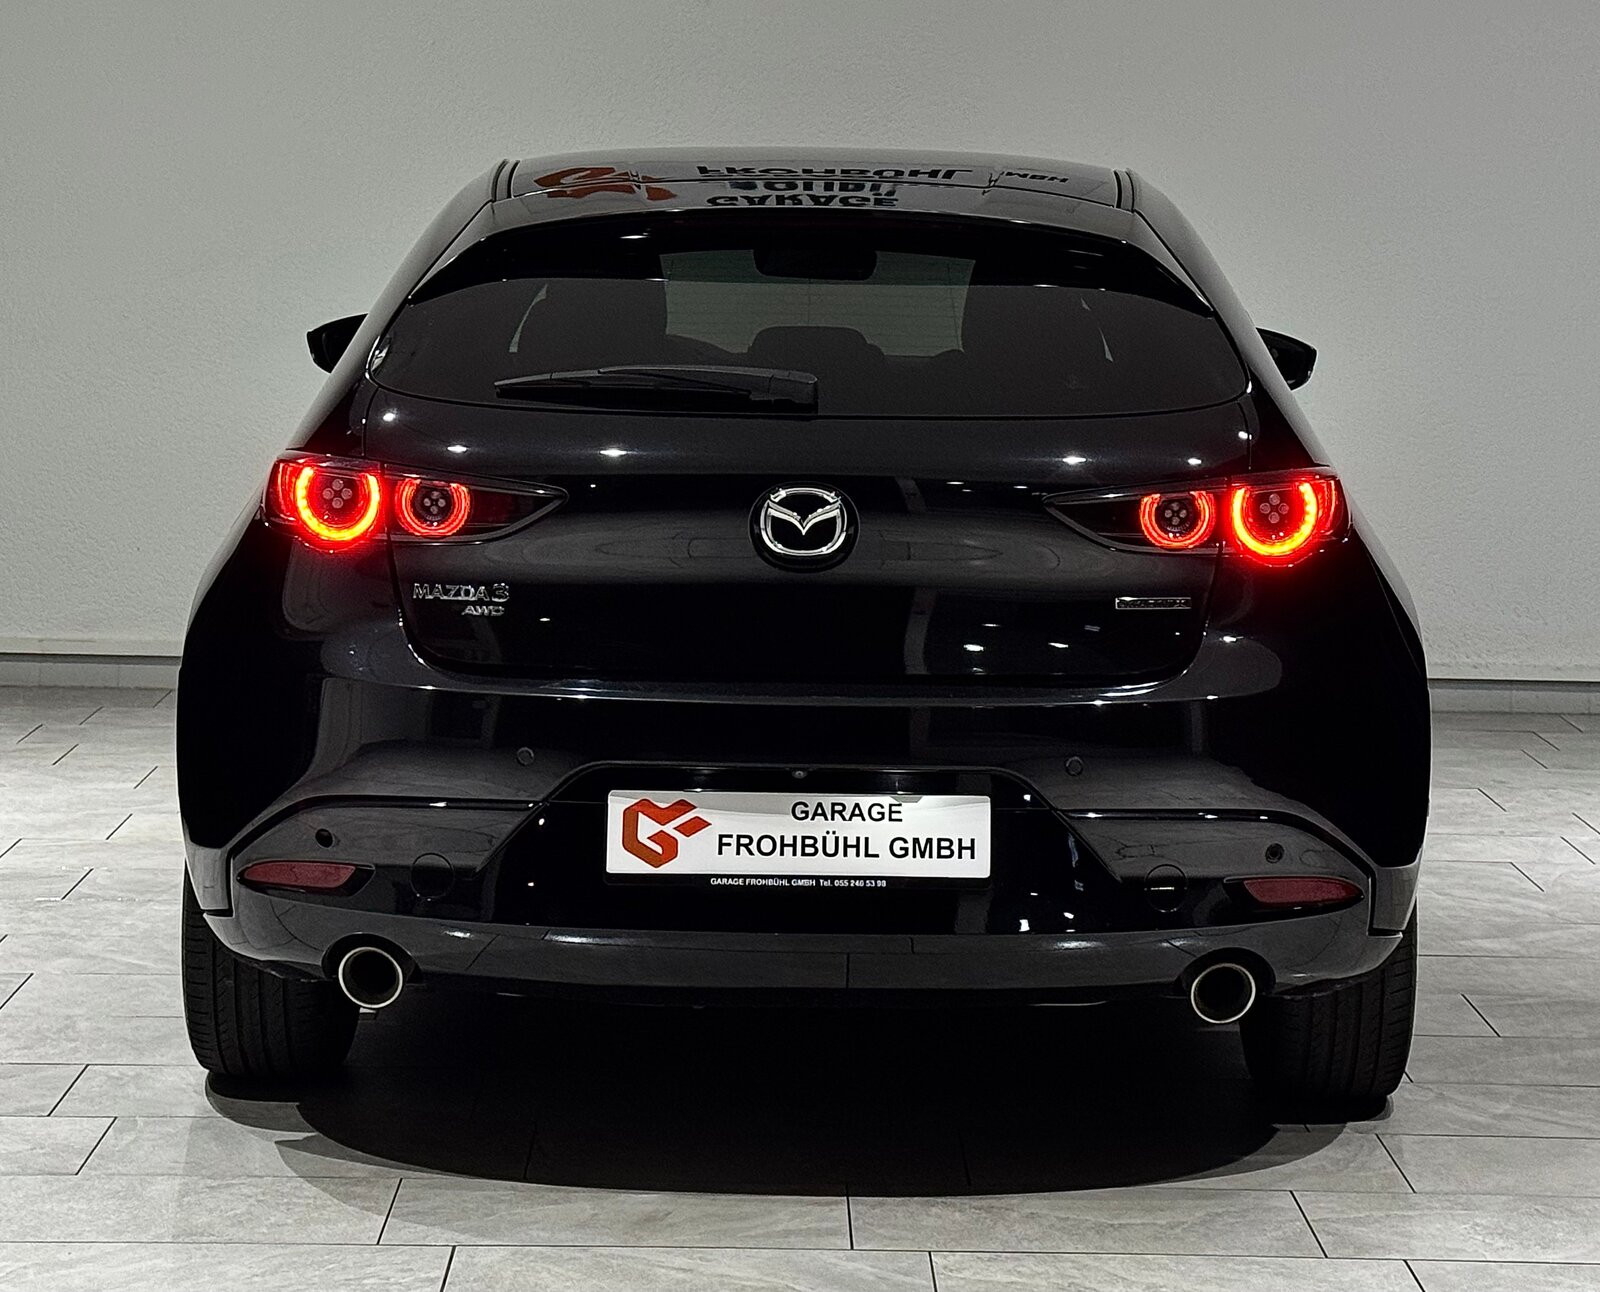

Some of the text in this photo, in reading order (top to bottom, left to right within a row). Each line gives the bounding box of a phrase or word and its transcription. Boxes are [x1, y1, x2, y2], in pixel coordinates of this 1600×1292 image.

[461, 605, 505, 616] AWD
[791, 801, 904, 822] GARAGE
[717, 830, 976, 860] FROHBÜHL GMBH
[710, 877, 744, 886] GARAGE
[746, 877, 790, 887] FROHBÜHL
[791, 879, 816, 887] GMBH
[820, 879, 833, 887] Tel.
[834, 879, 849, 887] 055
